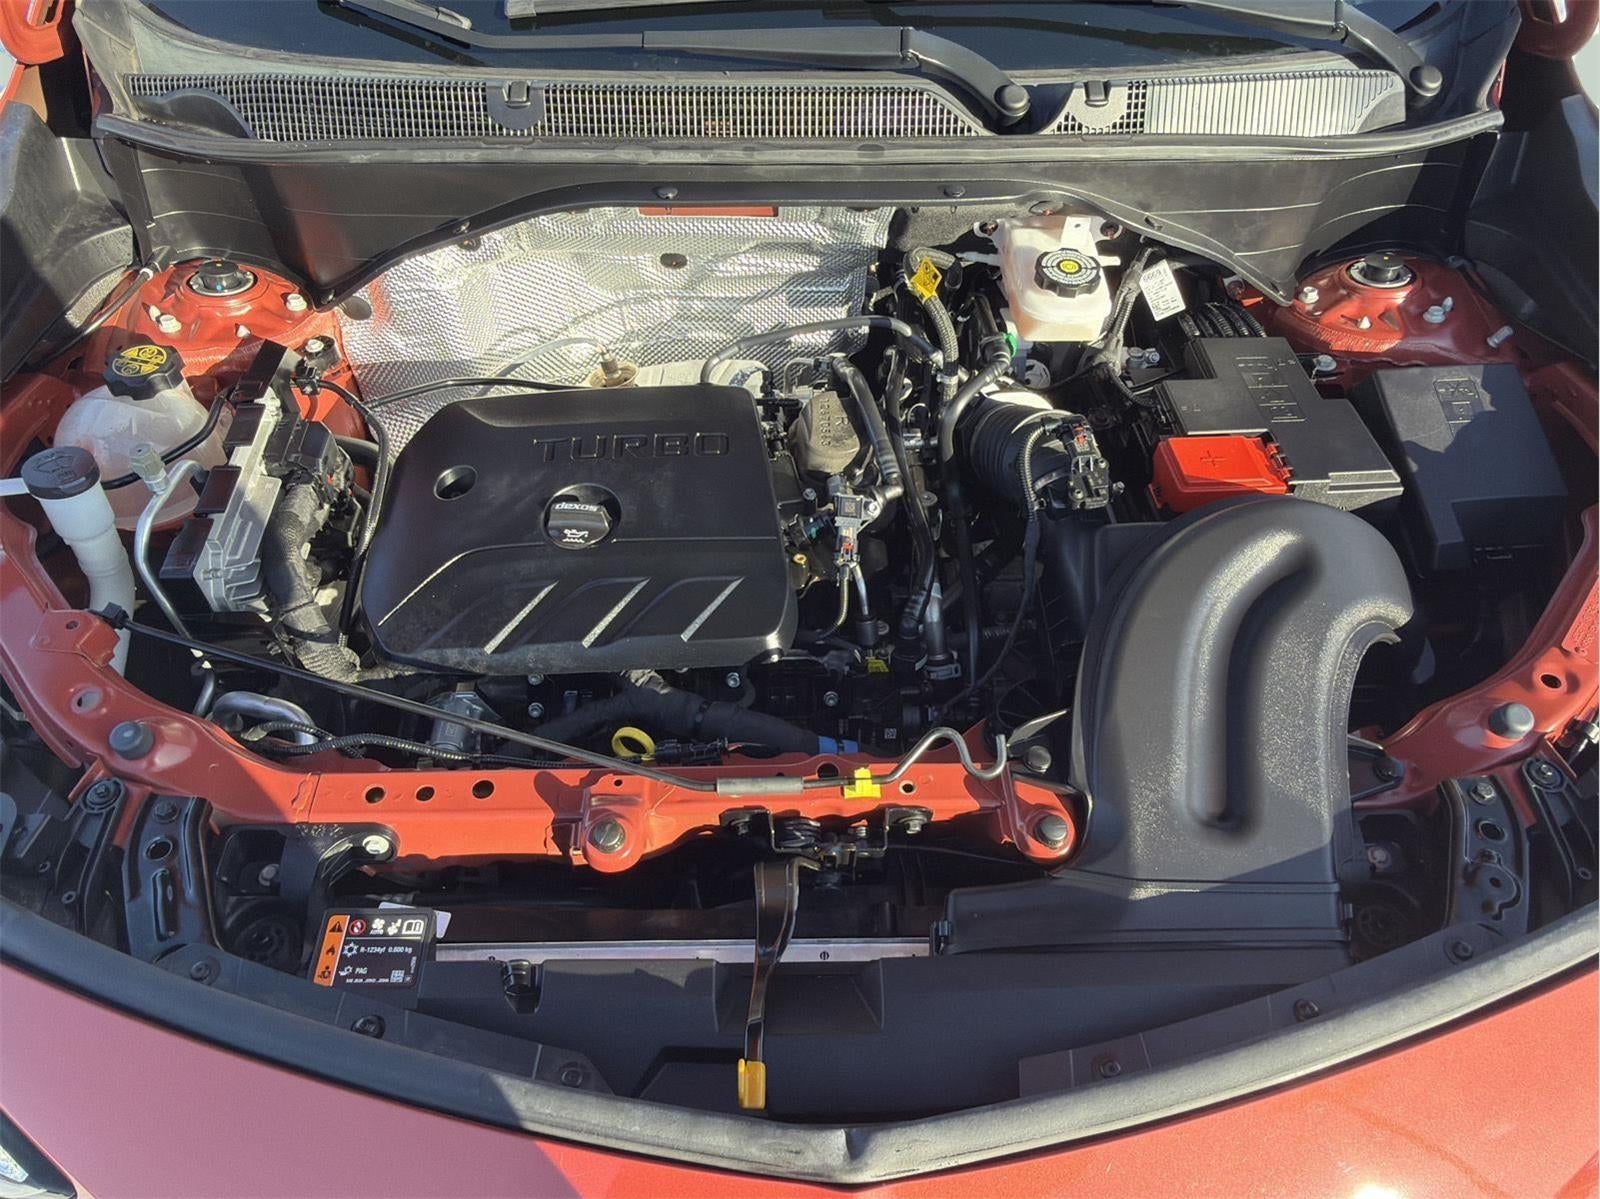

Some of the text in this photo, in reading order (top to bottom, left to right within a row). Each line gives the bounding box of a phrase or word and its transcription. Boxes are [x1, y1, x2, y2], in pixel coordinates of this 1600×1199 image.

[533, 432, 730, 462] TURBO
[554, 501, 598, 512] dexos
[355, 967, 368, 975] PAG
